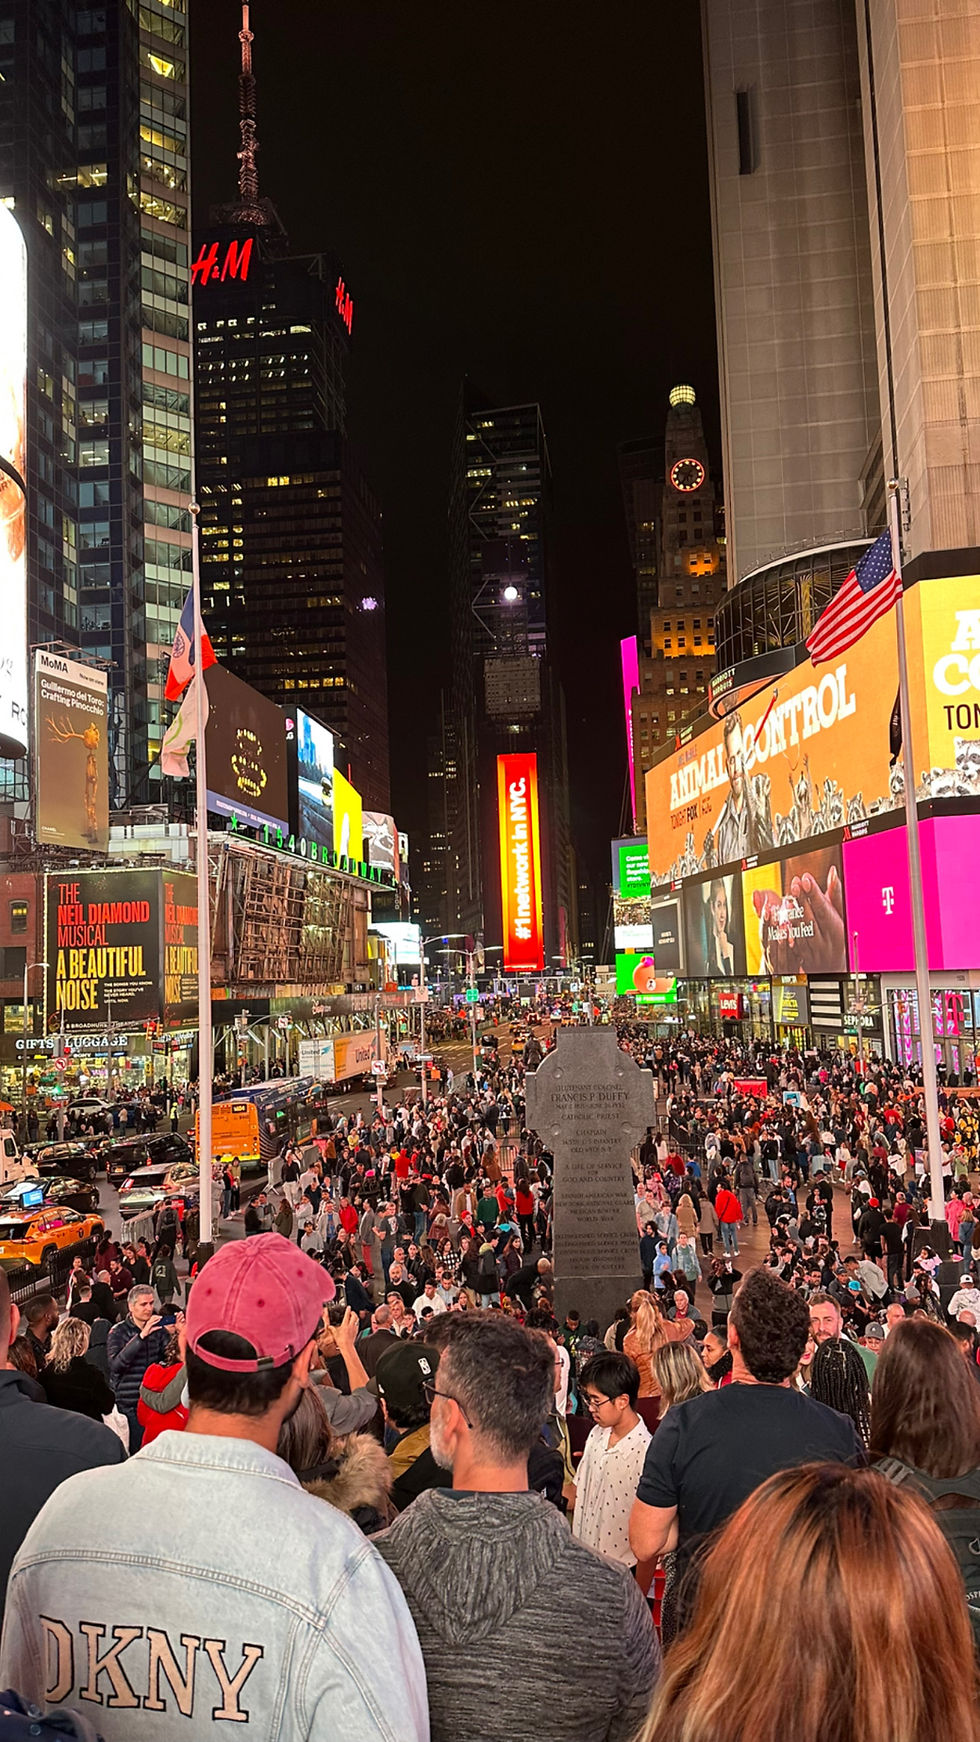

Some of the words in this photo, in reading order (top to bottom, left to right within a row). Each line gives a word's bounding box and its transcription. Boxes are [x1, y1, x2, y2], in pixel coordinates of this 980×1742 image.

[191, 238, 253, 285] H&M
[41, 655, 69, 673] MoMA
[41, 679, 76, 698] Guillermo
[76, 689, 87, 702] del
[41, 689, 71, 708] Crafting
[71, 699, 104, 717] Pinocchio
[670, 743, 729, 811] ANIMAL
[742, 663, 856, 771] CONTROL
[509, 778, 526, 821] NYC.
[687, 803, 698, 822] FOX
[512, 823, 527, 839] in
[310, 841, 382, 882] BROADWAY
[59, 883, 80, 904] THE
[58, 904, 86, 926] NEIL
[88, 901, 150, 925] DIAMOND
[58, 925, 109, 947] MUSICAL
[800, 920, 814, 938] Feel
[56, 949, 67, 979] A
[69, 946, 146, 979] BEAUTIFUL
[56, 979, 98, 1010] NOISE
[15, 1038, 54, 1050] GIFTS
[65, 1036, 128, 1048] LUGGAGE
[551, 1093, 587, 1102] FRANCIS
[598, 1092, 629, 1101] DUFFY
[38, 1614, 264, 1723] DKNY
